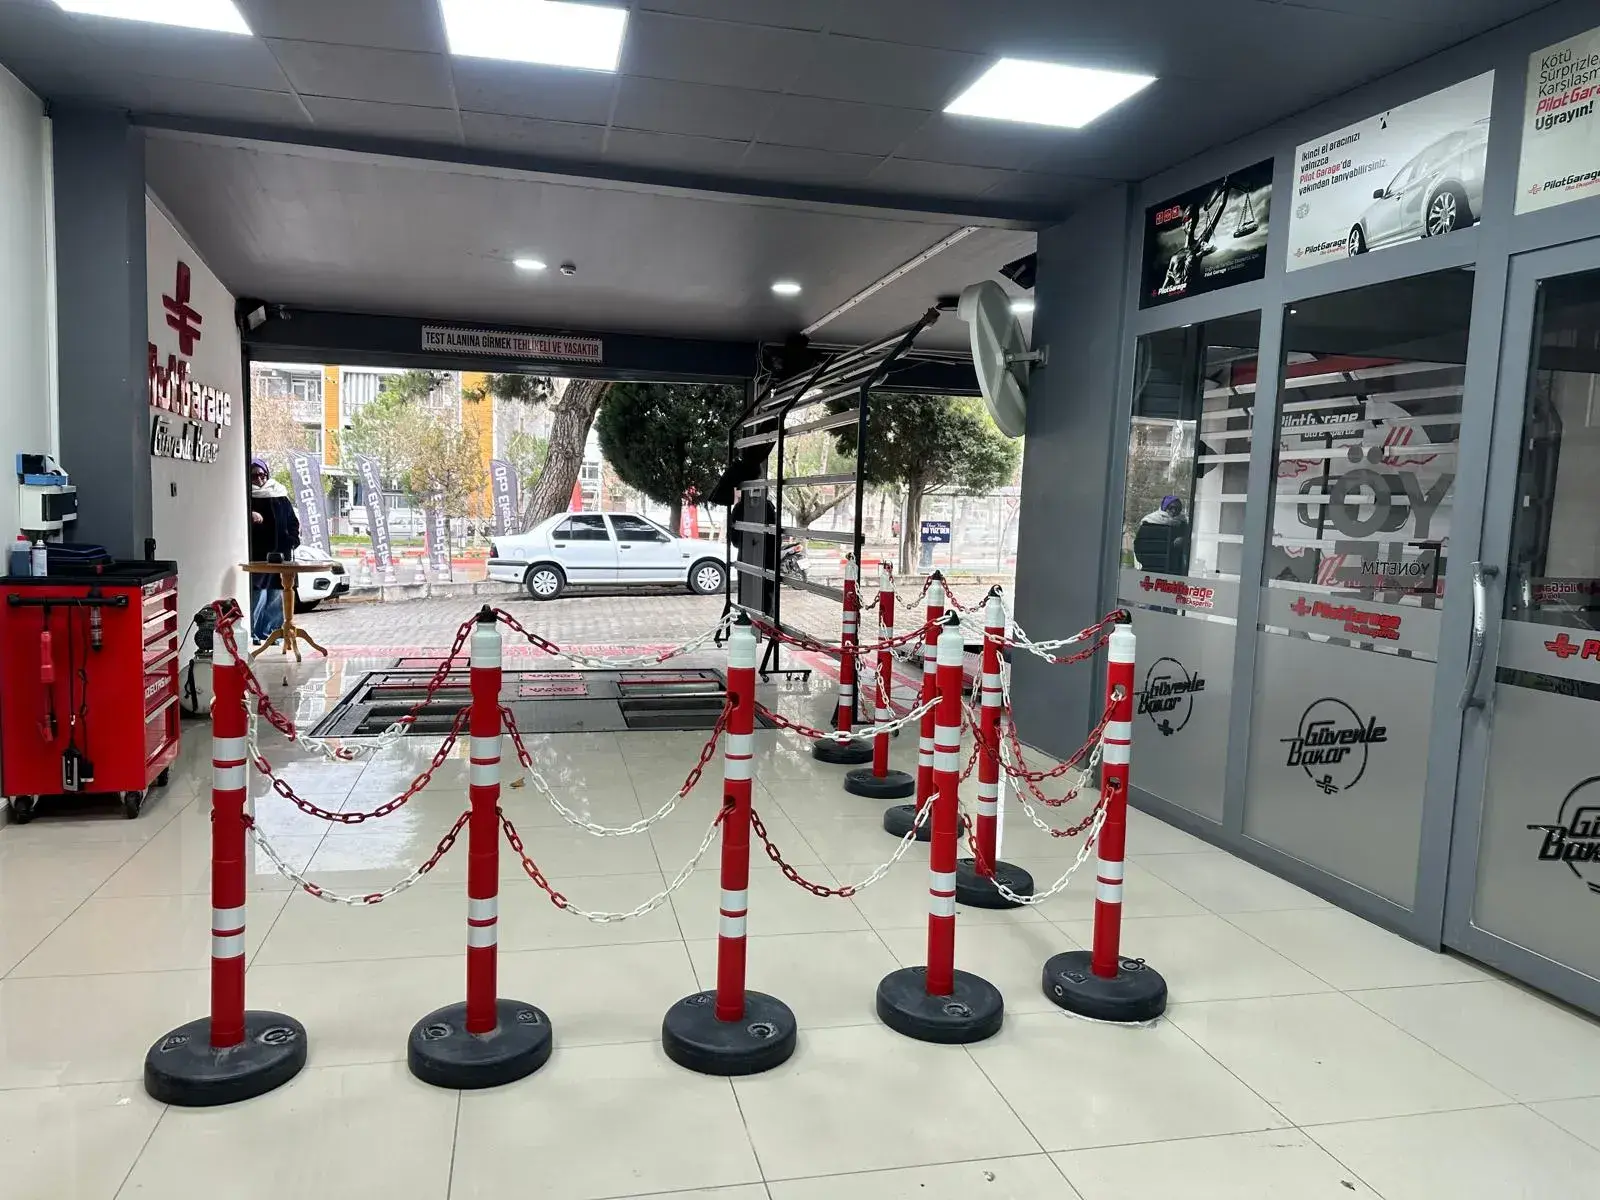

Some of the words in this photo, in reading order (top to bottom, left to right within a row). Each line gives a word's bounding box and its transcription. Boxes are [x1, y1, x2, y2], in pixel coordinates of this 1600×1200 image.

[1540, 54, 1600, 85] Sürprizle
[1541, 48, 1572, 71] Kötü
[1535, 100, 1594, 131] Uğrayın!
[1536, 92, 1570, 115] Pilot
[1321, 143, 1329, 155] el
[1329, 132, 1361, 152] aracınızı
[1299, 170, 1317, 184] Pilot
[1316, 159, 1352, 179] Garage'da
[1300, 156, 1329, 174] yalnızca
[1298, 178, 1330, 197] yakından
[1543, 169, 1600, 191] PilotGarag
[1304, 238, 1348, 255] PilotGarage
[425, 331, 445, 345] TEST
[446, 333, 481, 348] ALANINA
[481, 335, 512, 350] GİRMEK
[552, 340, 562, 353] VE
[563, 341, 599, 356] YASAKTIR
[1150, 671, 1206, 699] Güvenle
[1133, 690, 1182, 715] Bakar
[1304, 715, 1388, 747] Güvenle
[1280, 738, 1351, 767] Bakar
